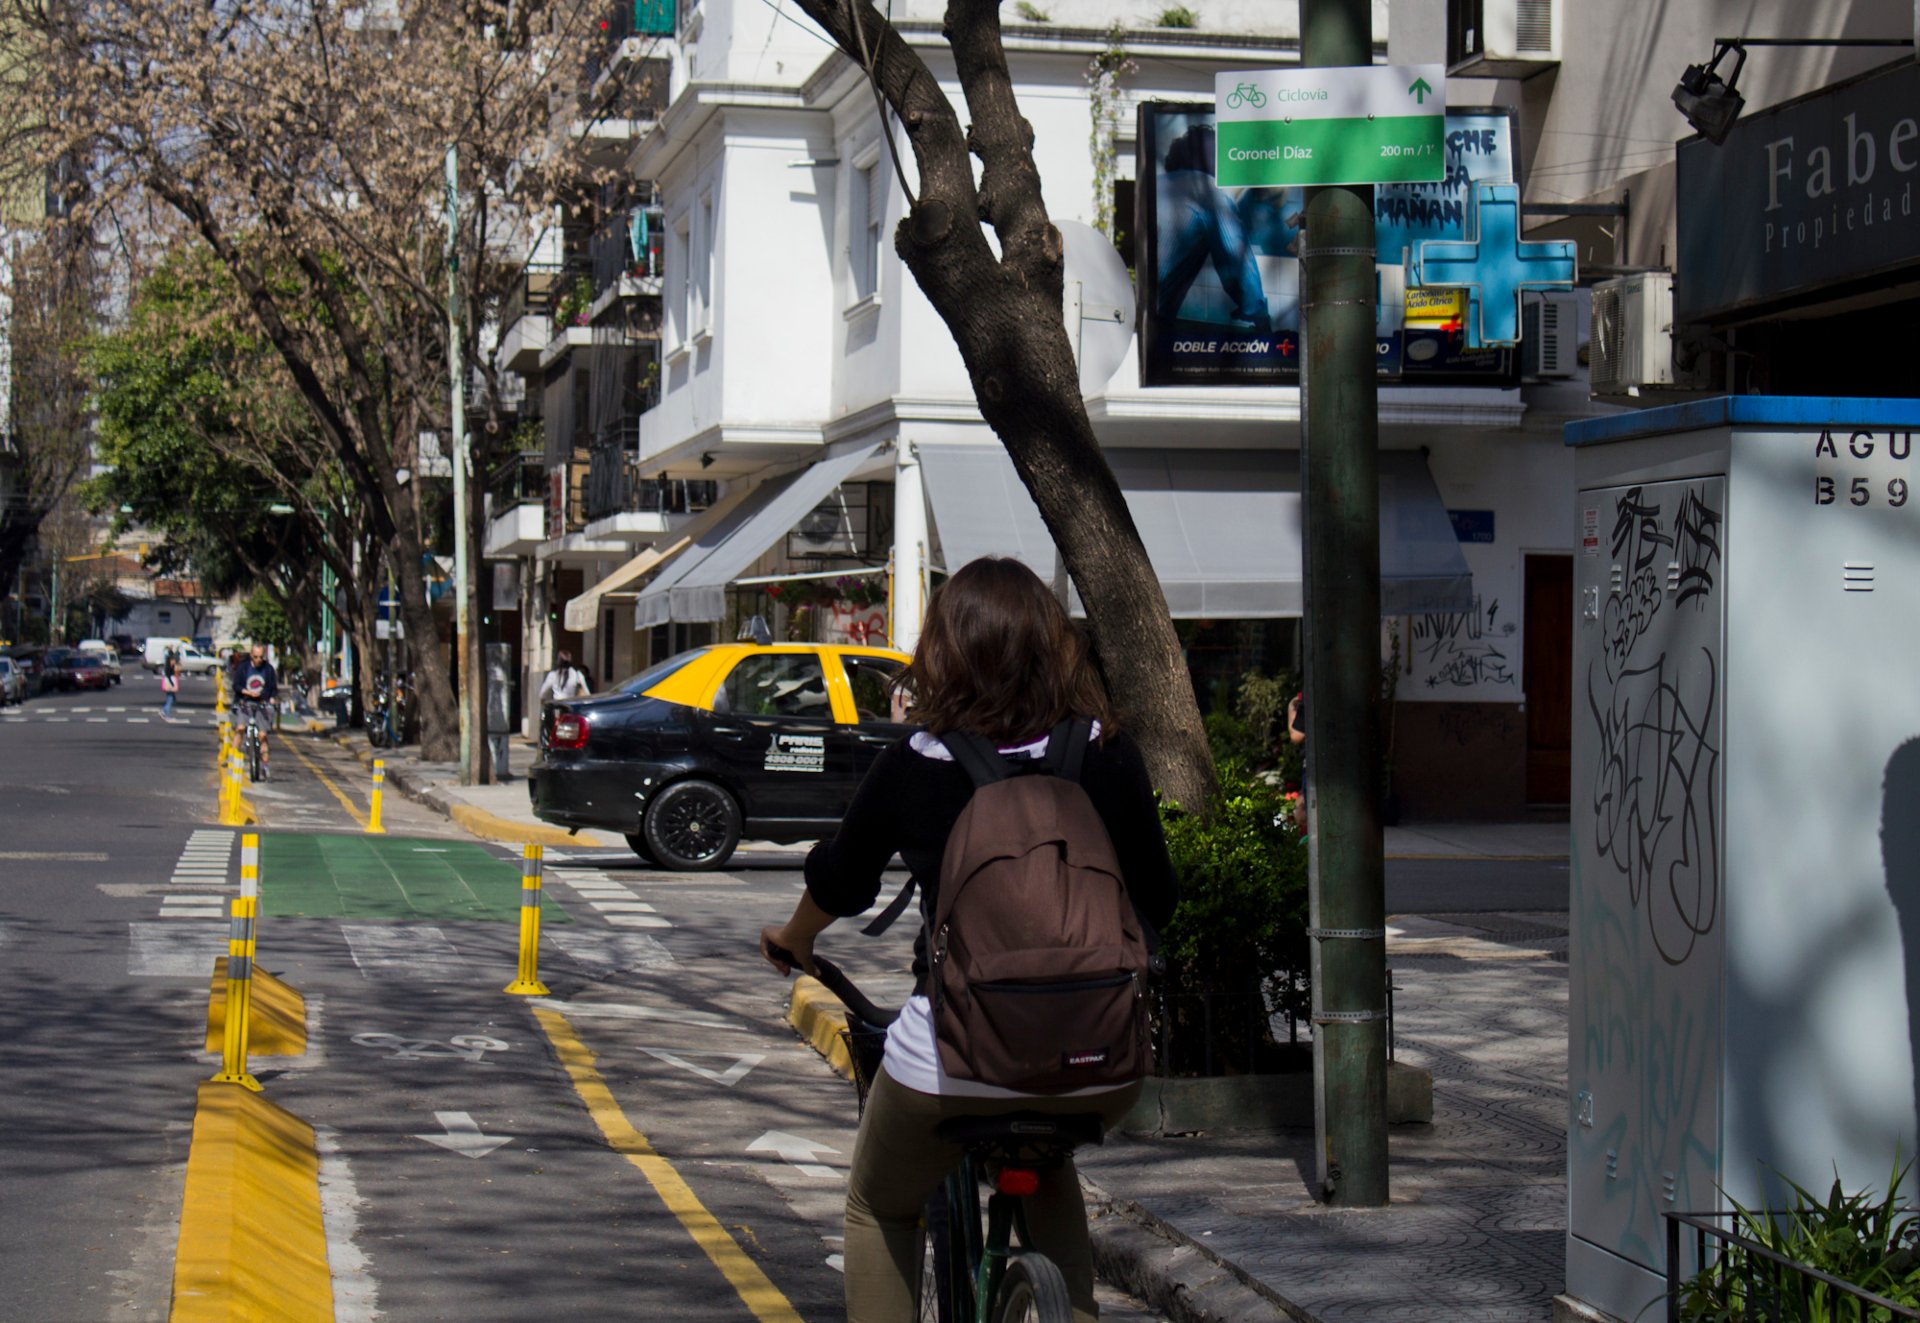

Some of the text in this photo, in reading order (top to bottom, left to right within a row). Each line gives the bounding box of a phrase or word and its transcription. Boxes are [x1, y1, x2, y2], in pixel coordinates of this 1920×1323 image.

[1278, 88, 1328, 102] Ciclovía
[1228, 146, 1279, 161] Coronel
[1283, 145, 1313, 160] Díaz
[1380, 146, 1401, 157] 200
[1403, 148, 1415, 156] m
[1416, 145, 1423, 157] /
[1446, 129, 1497, 157] CHE
[1376, 193, 1464, 230] MAÑAN
[1765, 182, 1911, 253] Propiedad
[1173, 339, 1270, 353] DOBLE ACCIÓN
[1815, 429, 1911, 460] AGU
[1815, 477, 1909, 508] B59
[779, 735, 824, 747] PARIS
[1069, 1054, 1105, 1065] EASTPAK
